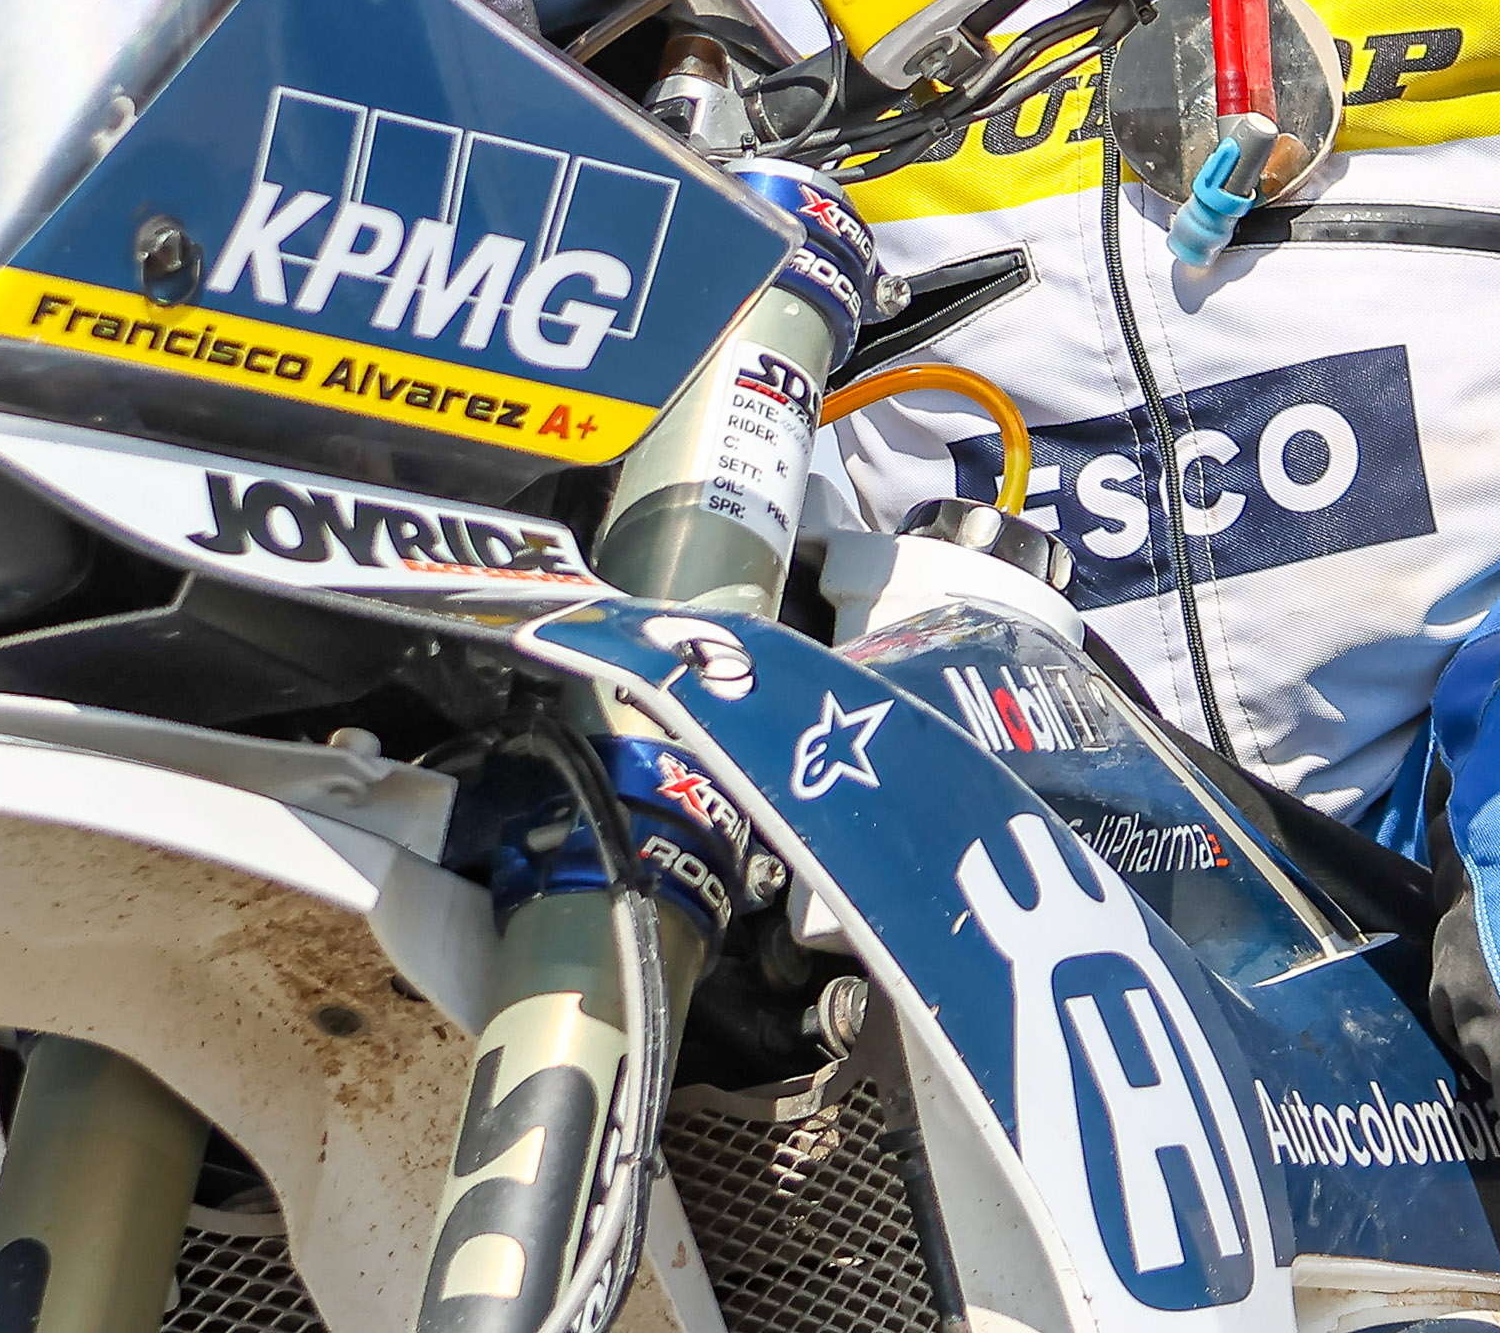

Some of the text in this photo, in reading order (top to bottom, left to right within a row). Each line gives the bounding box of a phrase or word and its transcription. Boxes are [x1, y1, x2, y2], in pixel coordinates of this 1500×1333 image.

[797, 183, 874, 262] XTRIG
[206, 180, 634, 371] KPMG
[31, 294, 599, 441] Francisco Alvarez A+
[732, 394, 779, 423] DATE:
[728, 415, 779, 446] RIDER:
[188, 469, 584, 575] JOYRIDE
[709, 495, 746, 519] SPR:
[943, 665, 1075, 753] Mobil
